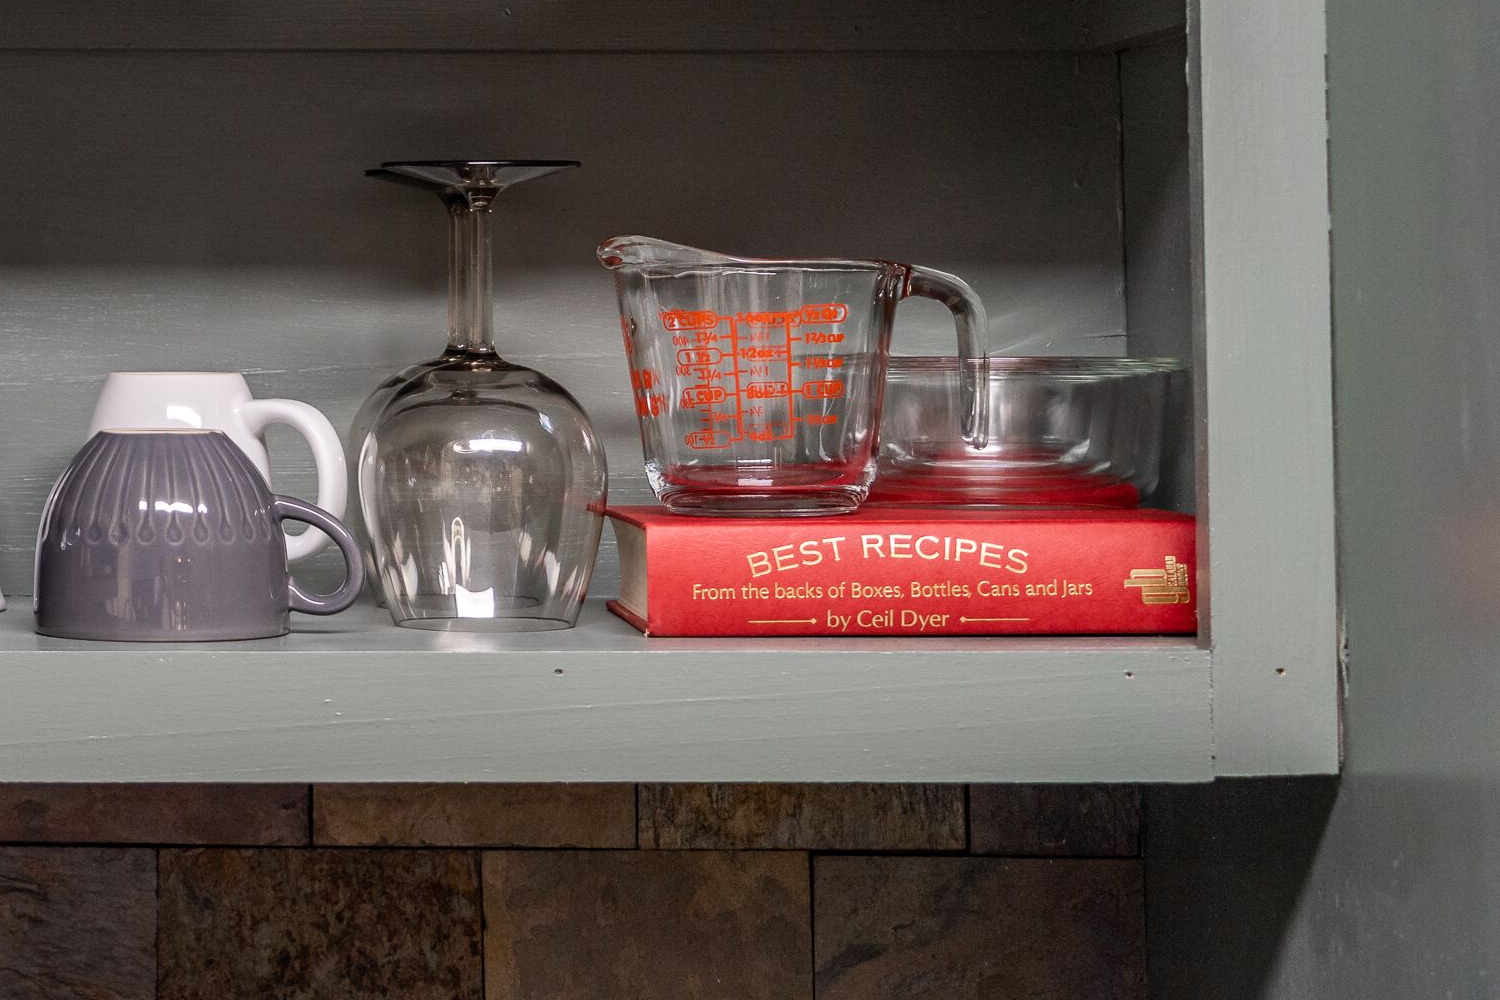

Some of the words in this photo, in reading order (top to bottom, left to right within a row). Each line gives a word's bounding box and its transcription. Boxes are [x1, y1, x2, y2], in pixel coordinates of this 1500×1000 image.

[745, 533, 847, 578] BEST
[859, 532, 1030, 574] RECIPES
[691, 582, 736, 601] From
[740, 583, 770, 600] the
[774, 581, 824, 600] backs
[827, 581, 847, 599] of
[851, 582, 905, 600] Boxes,
[910, 580, 972, 600] Bottles,
[977, 580, 1020, 598] Cans
[1025, 578, 1058, 597] and
[1061, 578, 1093, 598] Jars
[827, 609, 851, 632] by
[857, 609, 894, 628] Ceil
[901, 610, 950, 632] Dyer
